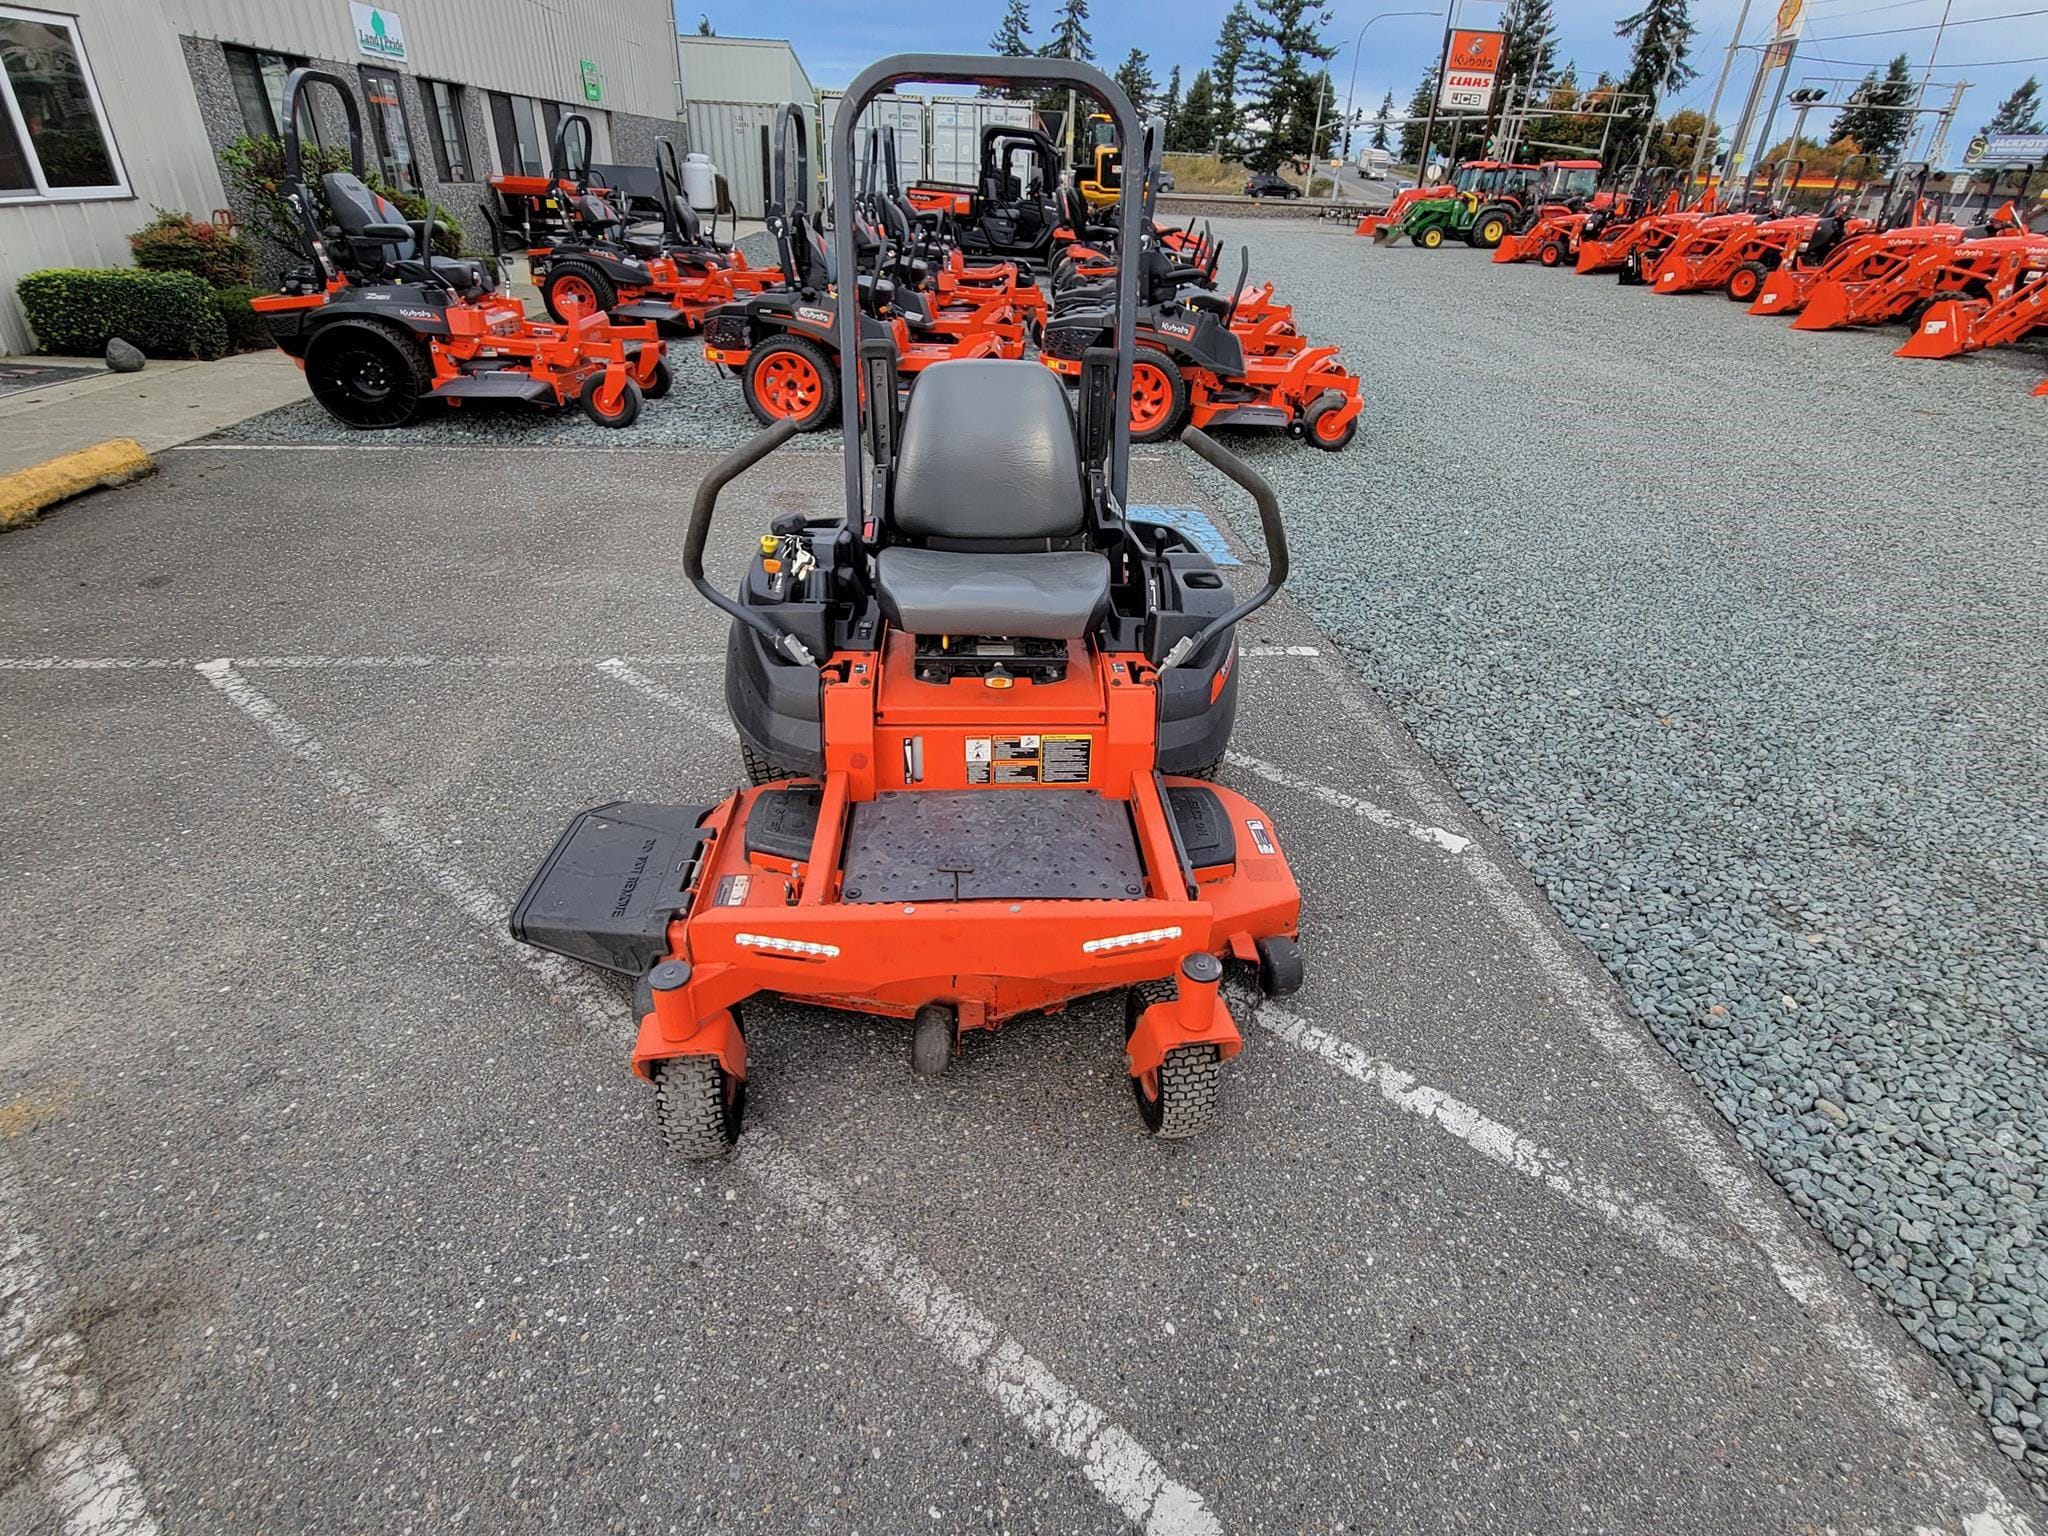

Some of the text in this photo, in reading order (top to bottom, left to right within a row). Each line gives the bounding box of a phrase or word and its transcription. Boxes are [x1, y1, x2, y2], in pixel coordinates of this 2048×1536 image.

[359, 29, 403, 51] Land Pride
[1455, 54, 1493, 68] Kubota
[1449, 76, 1491, 88] CLAAS
[1452, 93, 1481, 105] JCB
[400, 309, 431, 318] Kubota
[800, 308, 828, 322] Kubota
[1161, 322, 1189, 334] Kubota
